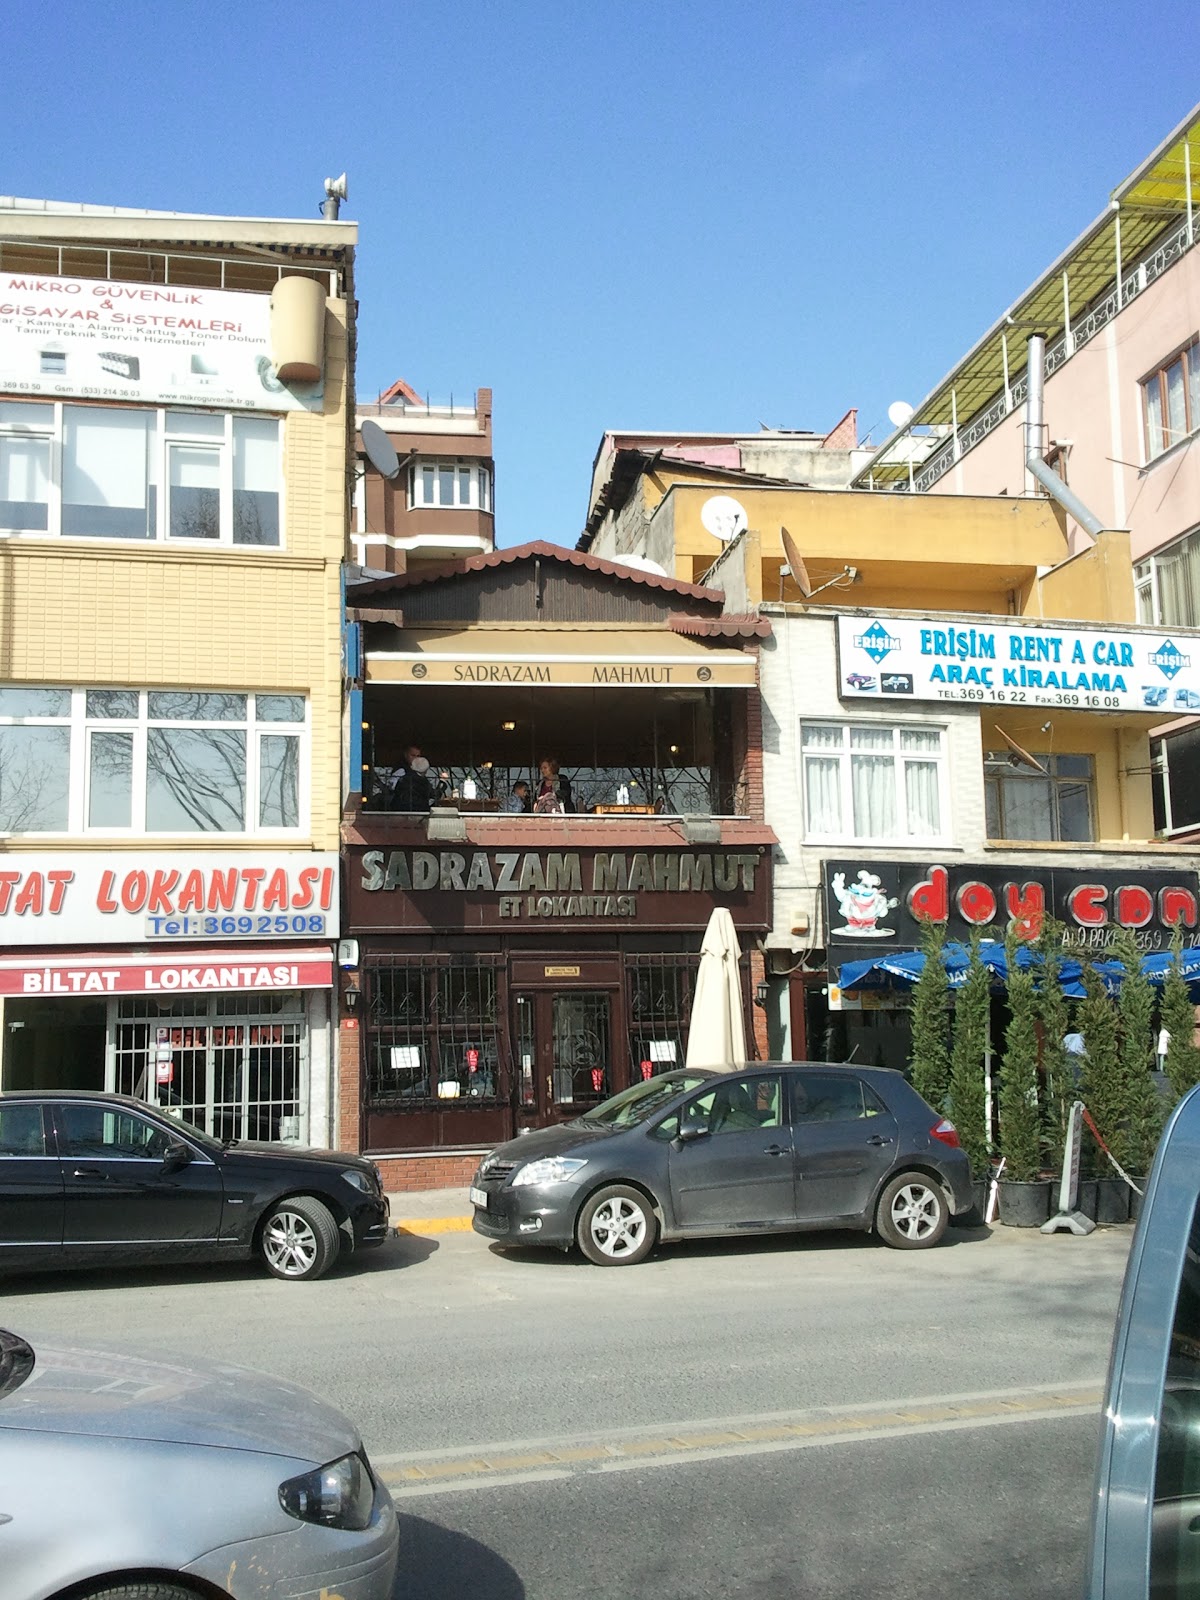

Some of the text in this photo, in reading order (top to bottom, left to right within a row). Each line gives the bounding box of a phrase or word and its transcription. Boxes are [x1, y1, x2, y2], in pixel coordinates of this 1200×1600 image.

[100, 299, 114, 310] &
[15, 326, 206, 347] Tamir Teknik Servis Hizmetleri
[26, 318, 75, 329] Kamera
[88, 323, 124, 333] Alarm
[137, 327, 177, 338] Kartuş
[190, 331, 224, 341] Toner
[228, 334, 267, 344] Dolum
[3, 381, 17, 389] 369
[19, 382, 29, 390] 63
[853, 633, 901, 653] ERİŞİM
[920, 627, 1135, 668] ERİŞİM RENT A CAR
[1148, 651, 1191, 671] ERİŞİM
[454, 664, 674, 684] SADRAZAM MAHMUT
[929, 664, 1128, 693] ARAÇ KİRALAMA
[990, 690, 1006, 702] 16
[1010, 691, 1027, 703] 22
[1084, 695, 1100, 707] 16
[1104, 696, 1121, 708] 08
[361, 850, 760, 892] SADRAZAM MAHMUT
[96, 867, 334, 917] LOKANTASI
[499, 895, 637, 918] ET LOKANTASI
[23, 966, 299, 993] BİLTAT LOKANTASI
